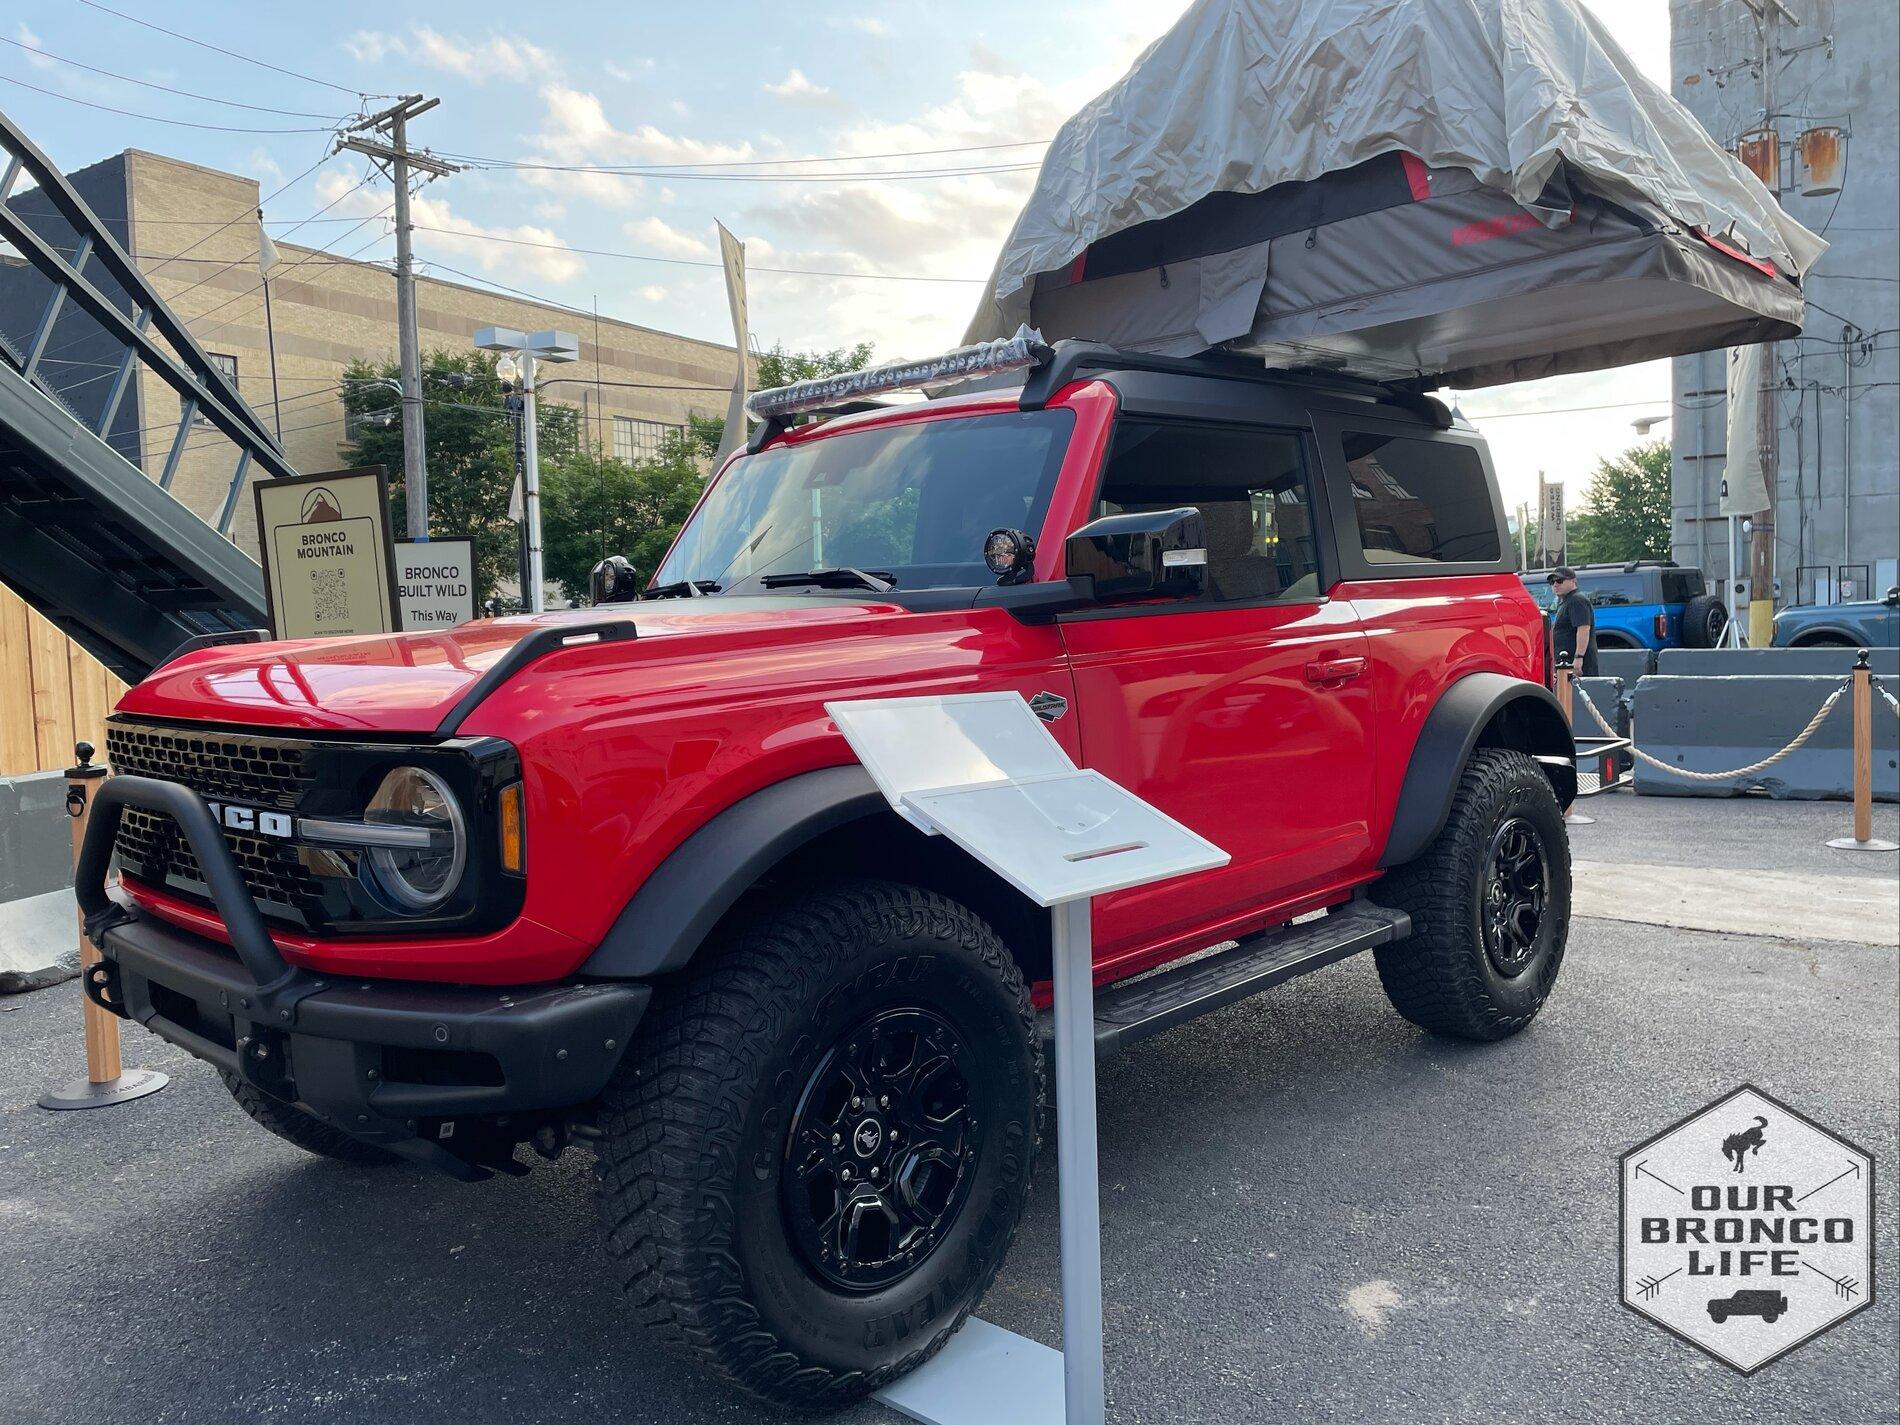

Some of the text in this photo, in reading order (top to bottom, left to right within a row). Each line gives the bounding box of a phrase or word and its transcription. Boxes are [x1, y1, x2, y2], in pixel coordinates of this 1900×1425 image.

[302, 531, 347, 545] BRONCO
[297, 545, 354, 559] MOUNTAIN
[405, 566, 459, 580] BRONCO
[399, 585, 467, 597] BUILT WILD
[411, 610, 458, 624] This Way
